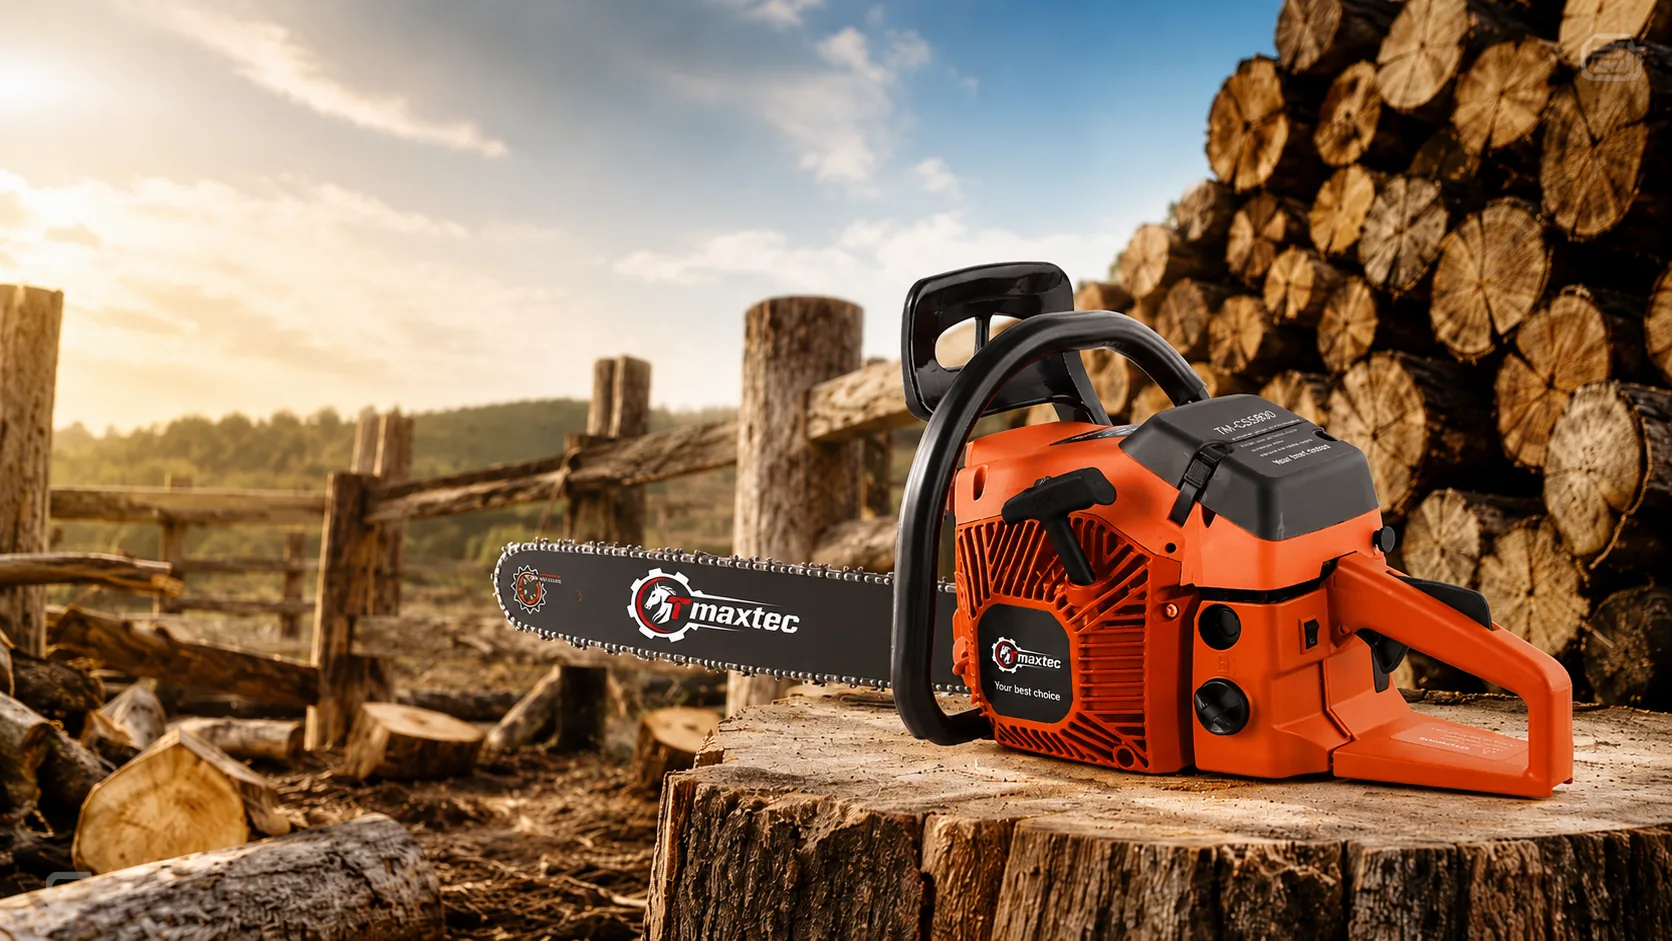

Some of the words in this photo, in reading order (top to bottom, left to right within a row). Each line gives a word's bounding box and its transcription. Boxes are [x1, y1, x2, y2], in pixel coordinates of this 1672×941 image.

[994, 680, 1013, 693] Your
[1014, 684, 1032, 696] best
[1033, 690, 1061, 701] choice
